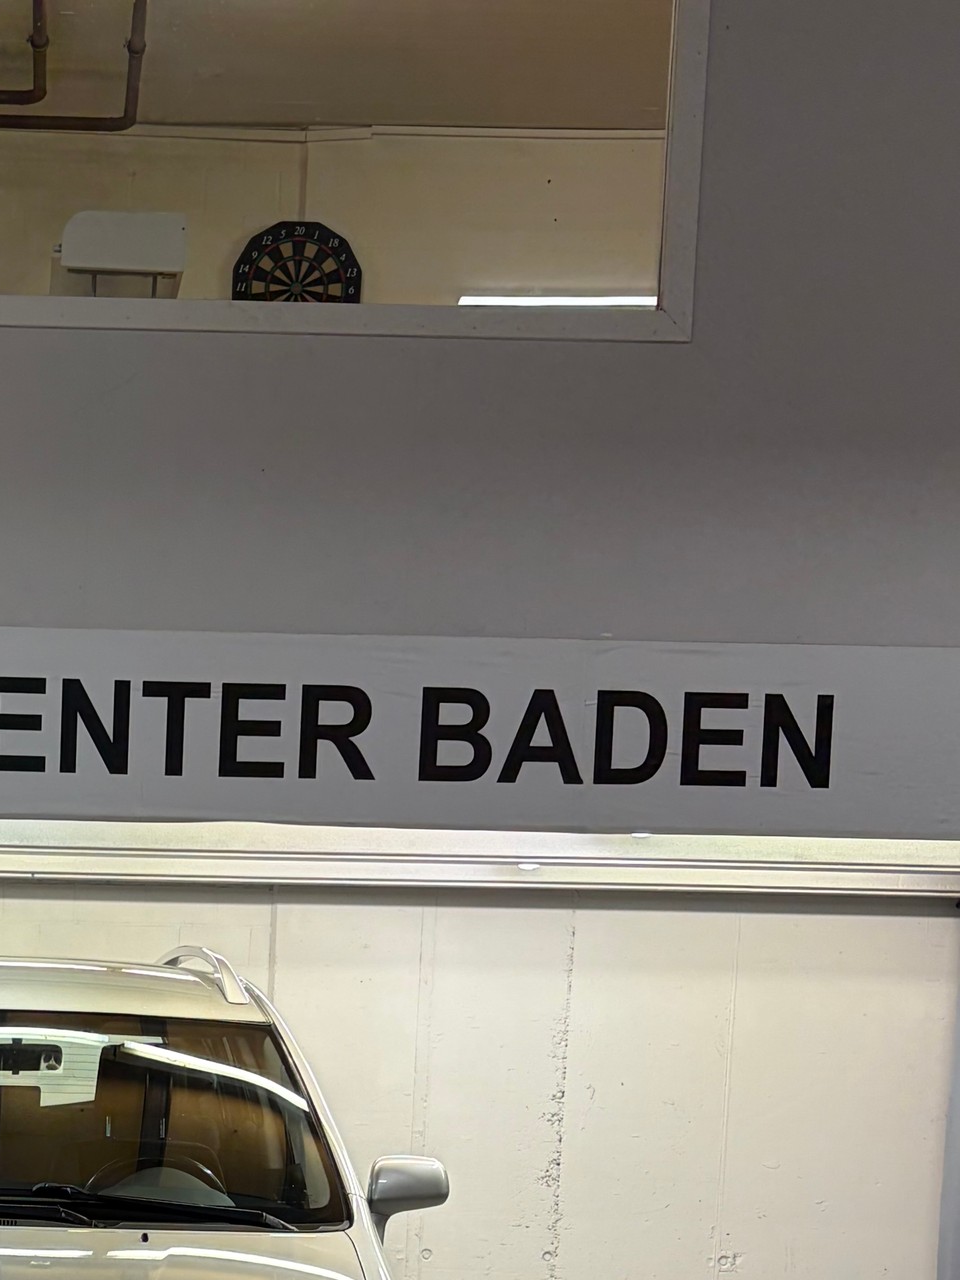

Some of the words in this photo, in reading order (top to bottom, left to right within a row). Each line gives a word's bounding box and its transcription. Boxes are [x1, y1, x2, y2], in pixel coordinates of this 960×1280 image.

[279, 229, 286, 238] 5
[294, 226, 305, 235] 20
[313, 230, 319, 239] 1
[262, 235, 272, 245] 12
[328, 238, 340, 248] 18
[251, 251, 258, 259] 9
[339, 253, 346, 261] 4
[239, 264, 249, 272] 14
[346, 268, 357, 277] 13
[236, 283, 246, 292] 11
[348, 286, 355, 294] 6
[418, 687, 834, 789] BADEN
